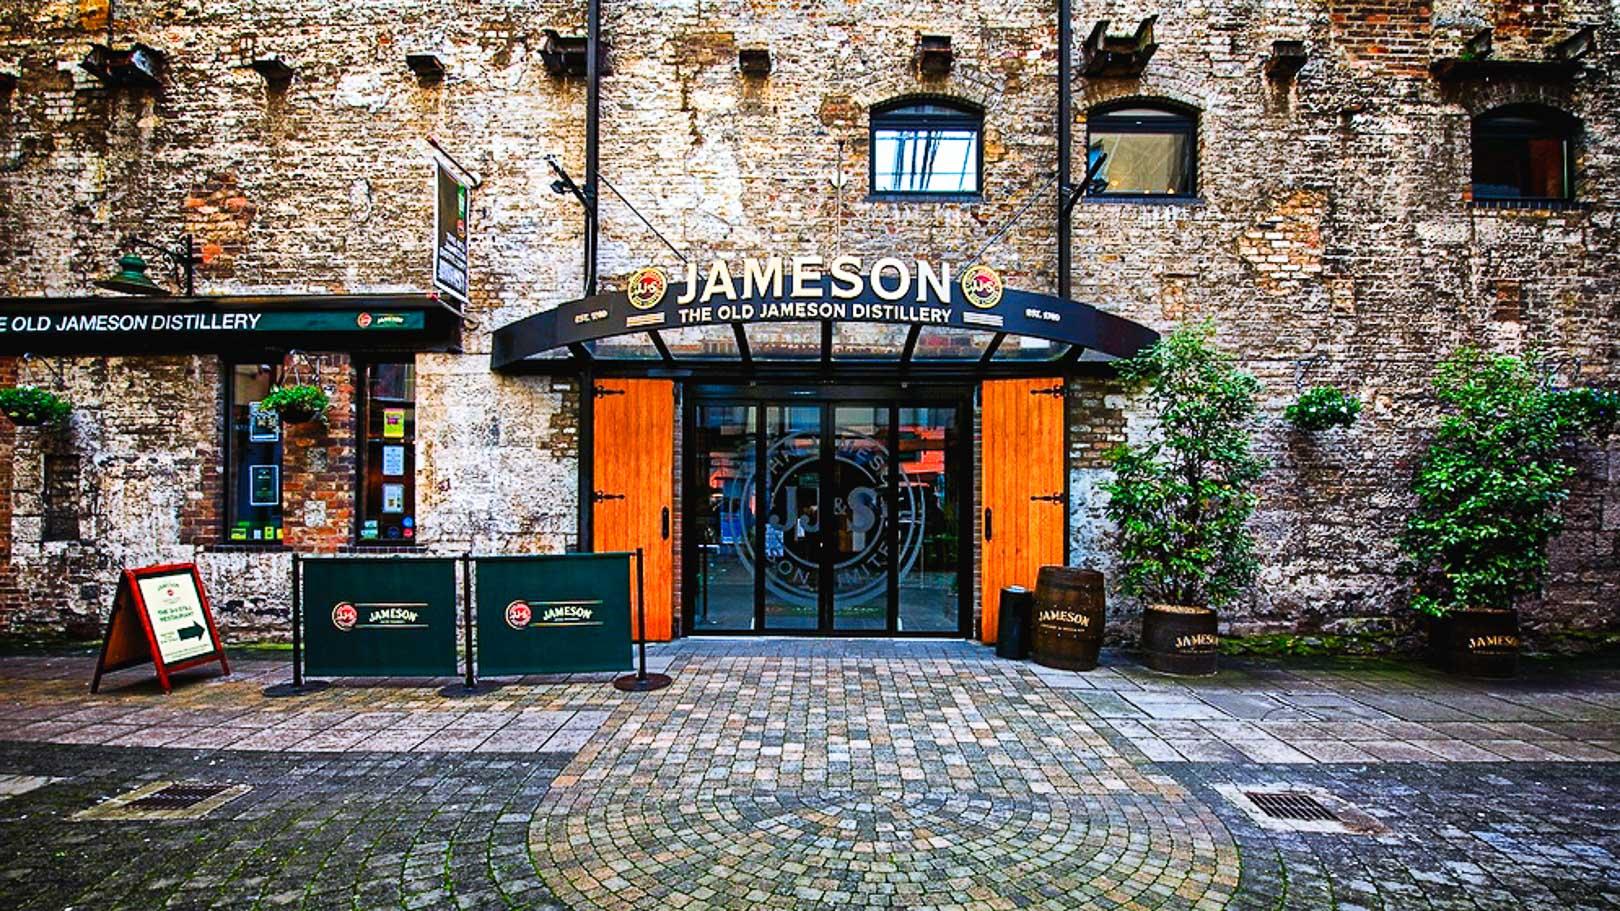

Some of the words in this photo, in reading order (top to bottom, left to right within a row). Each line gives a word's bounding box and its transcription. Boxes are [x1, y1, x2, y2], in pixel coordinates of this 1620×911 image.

[677, 256, 951, 305] JAMESON
[678, 306, 712, 323] THE
[717, 304, 754, 320] OLD
[760, 302, 846, 318] JAMESON
[852, 303, 952, 322] DISTILLERY
[11, 316, 52, 332] OLD
[56, 315, 148, 331] JAMESON
[151, 313, 262, 330] DISTILLERY
[368, 608, 418, 623] JAMESON
[543, 606, 593, 621] JAMESON
[1038, 609, 1090, 627] JAMESON
